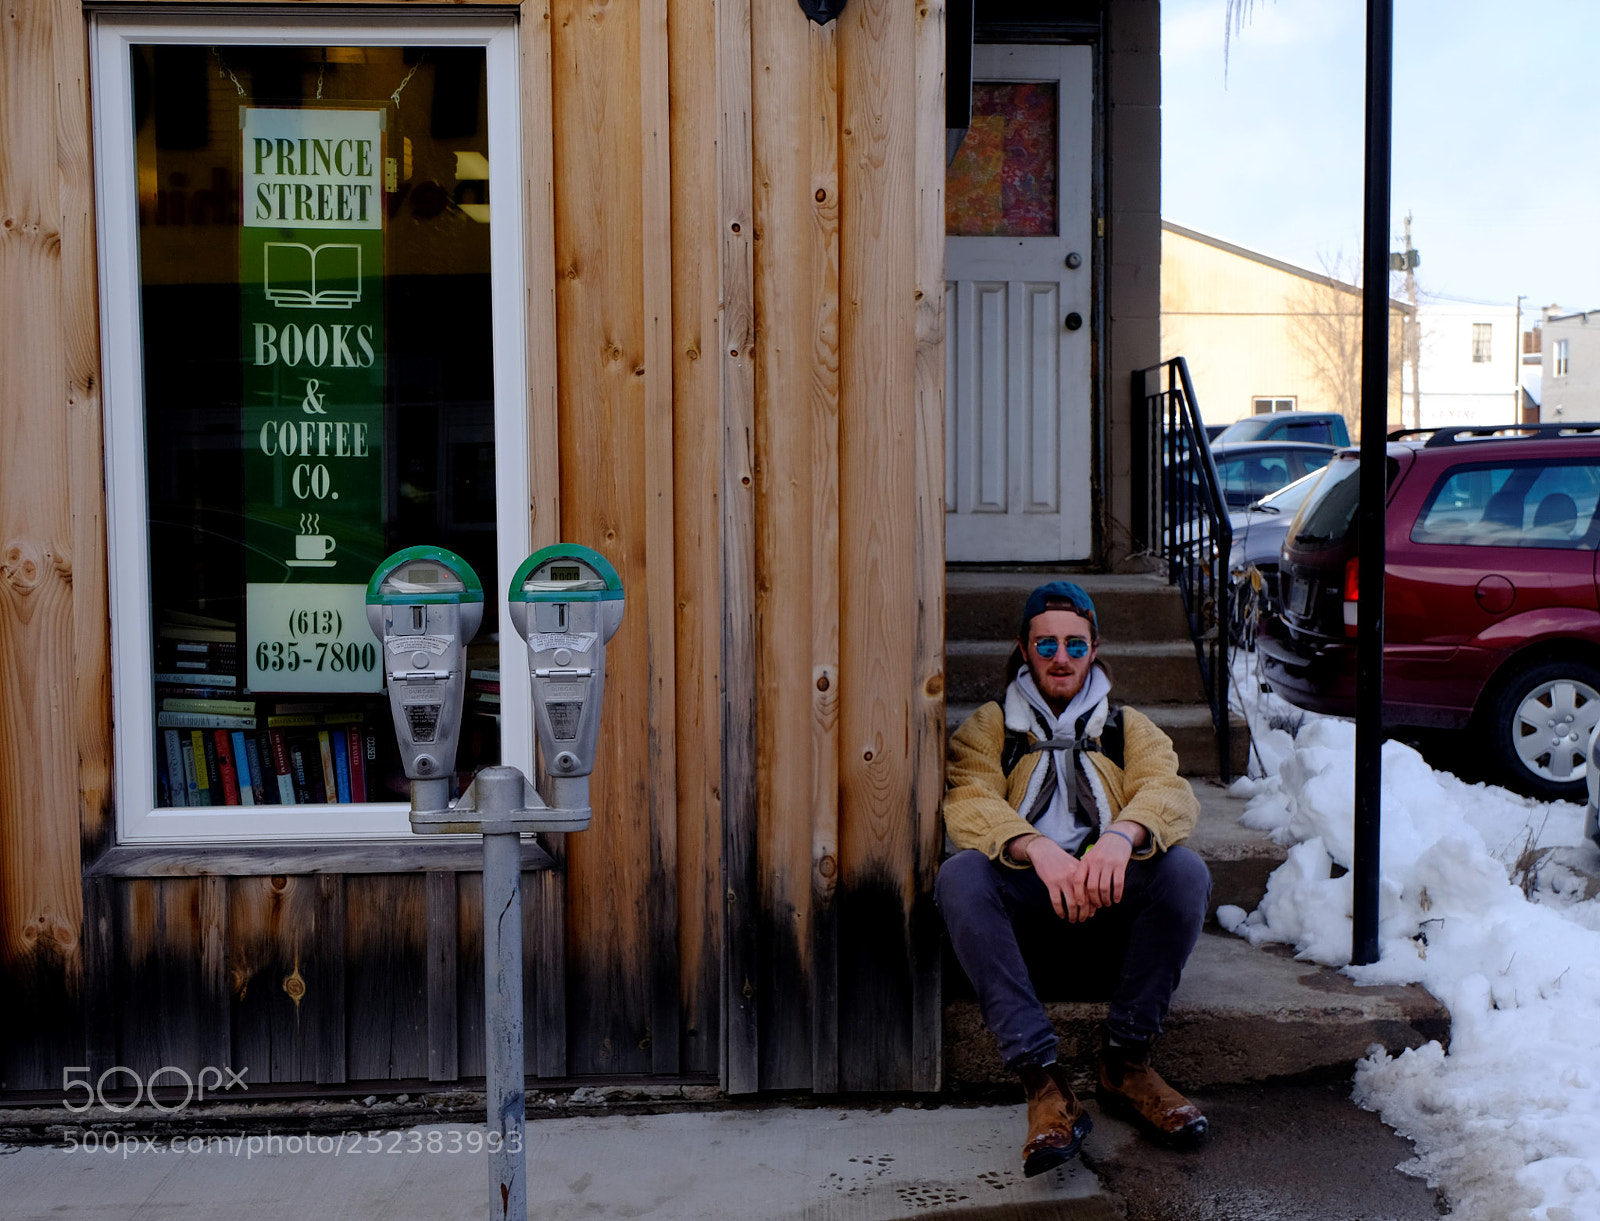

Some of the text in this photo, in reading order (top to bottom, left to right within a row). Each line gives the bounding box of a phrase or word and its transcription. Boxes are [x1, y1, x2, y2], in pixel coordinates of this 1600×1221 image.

[252, 137, 373, 177] PRINCE
[255, 182, 372, 221] STREET
[252, 322, 375, 368] BOOKS
[302, 378, 328, 415] &
[259, 420, 369, 457] COFFEE
[292, 463, 339, 500] CO.
[288, 608, 343, 639] (613)
[255, 641, 376, 673] 635-7800
